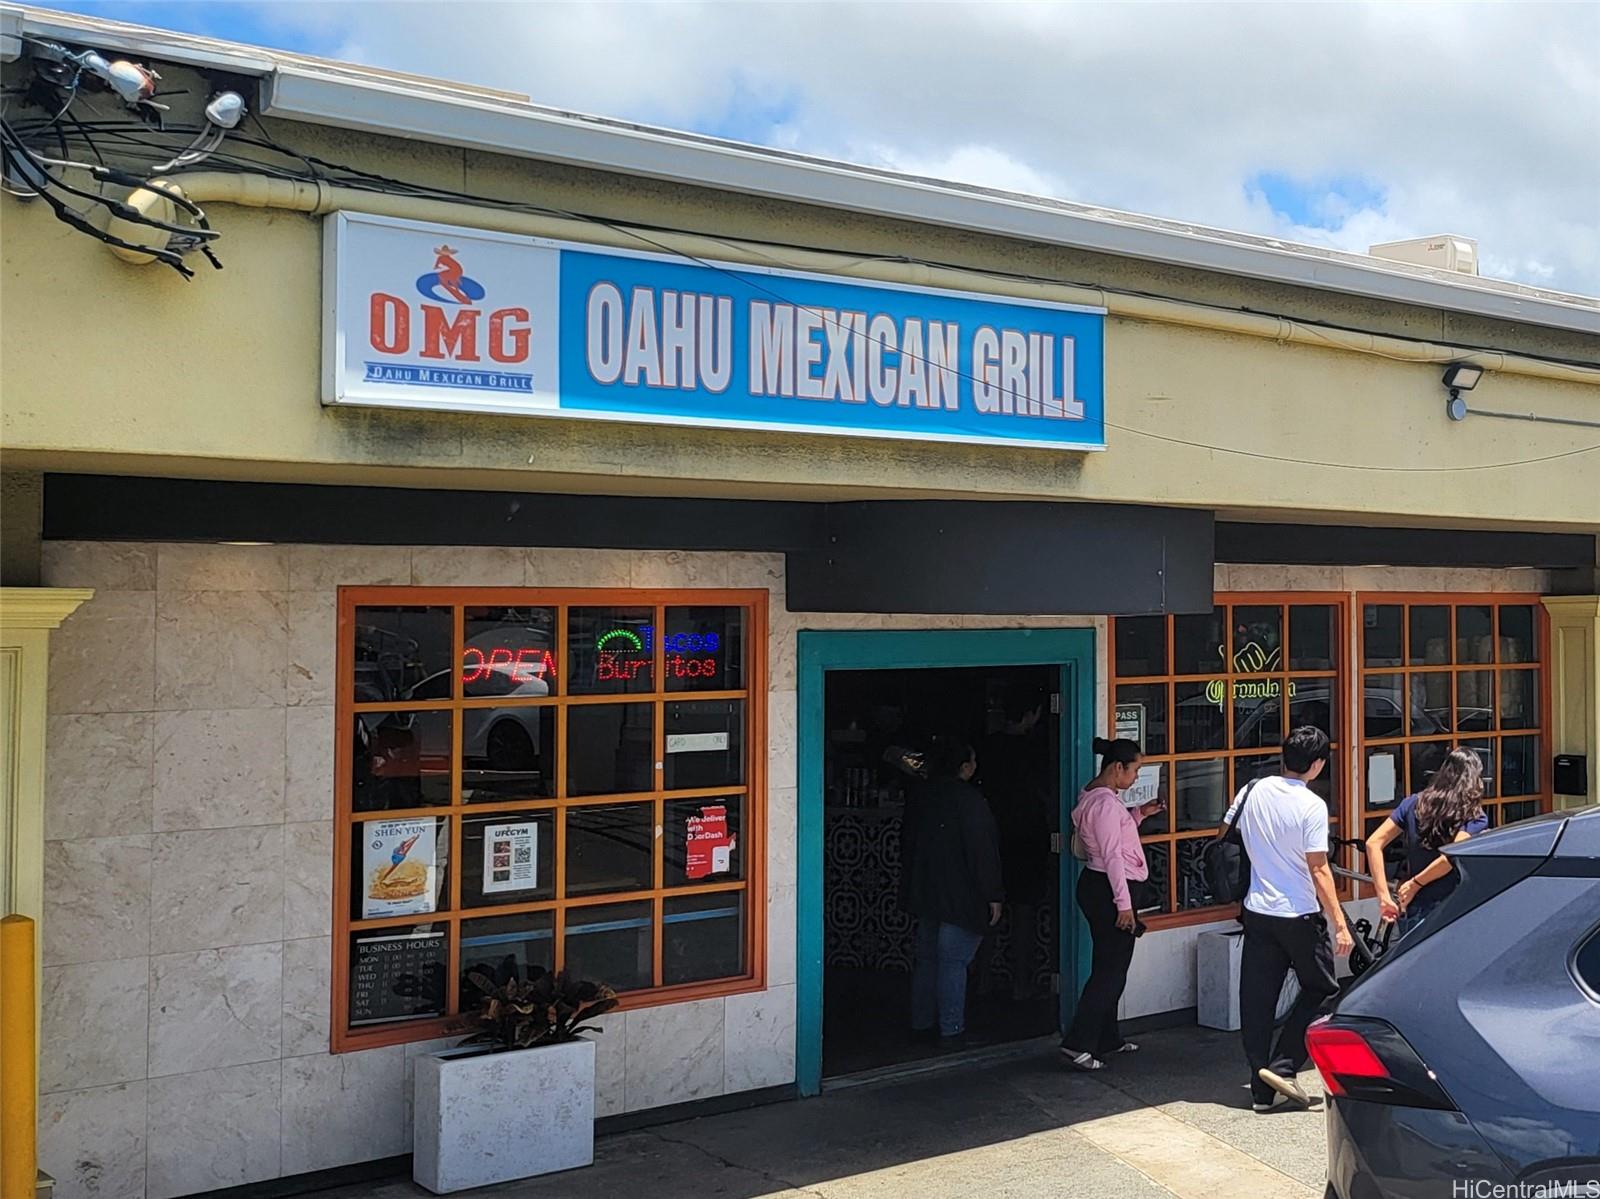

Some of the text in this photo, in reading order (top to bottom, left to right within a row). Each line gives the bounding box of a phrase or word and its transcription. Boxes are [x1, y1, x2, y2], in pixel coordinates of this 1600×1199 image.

[370, 292, 532, 364] OMG
[586, 281, 1085, 421] OAHU MEXICAN GRILL
[488, 375, 528, 389] GRILL
[461, 647, 557, 682] OPEN
[1115, 711, 1138, 720] PASS
[374, 826, 426, 837] SHEN YUN
[360, 940, 440, 954] BUSINESS HOURS
